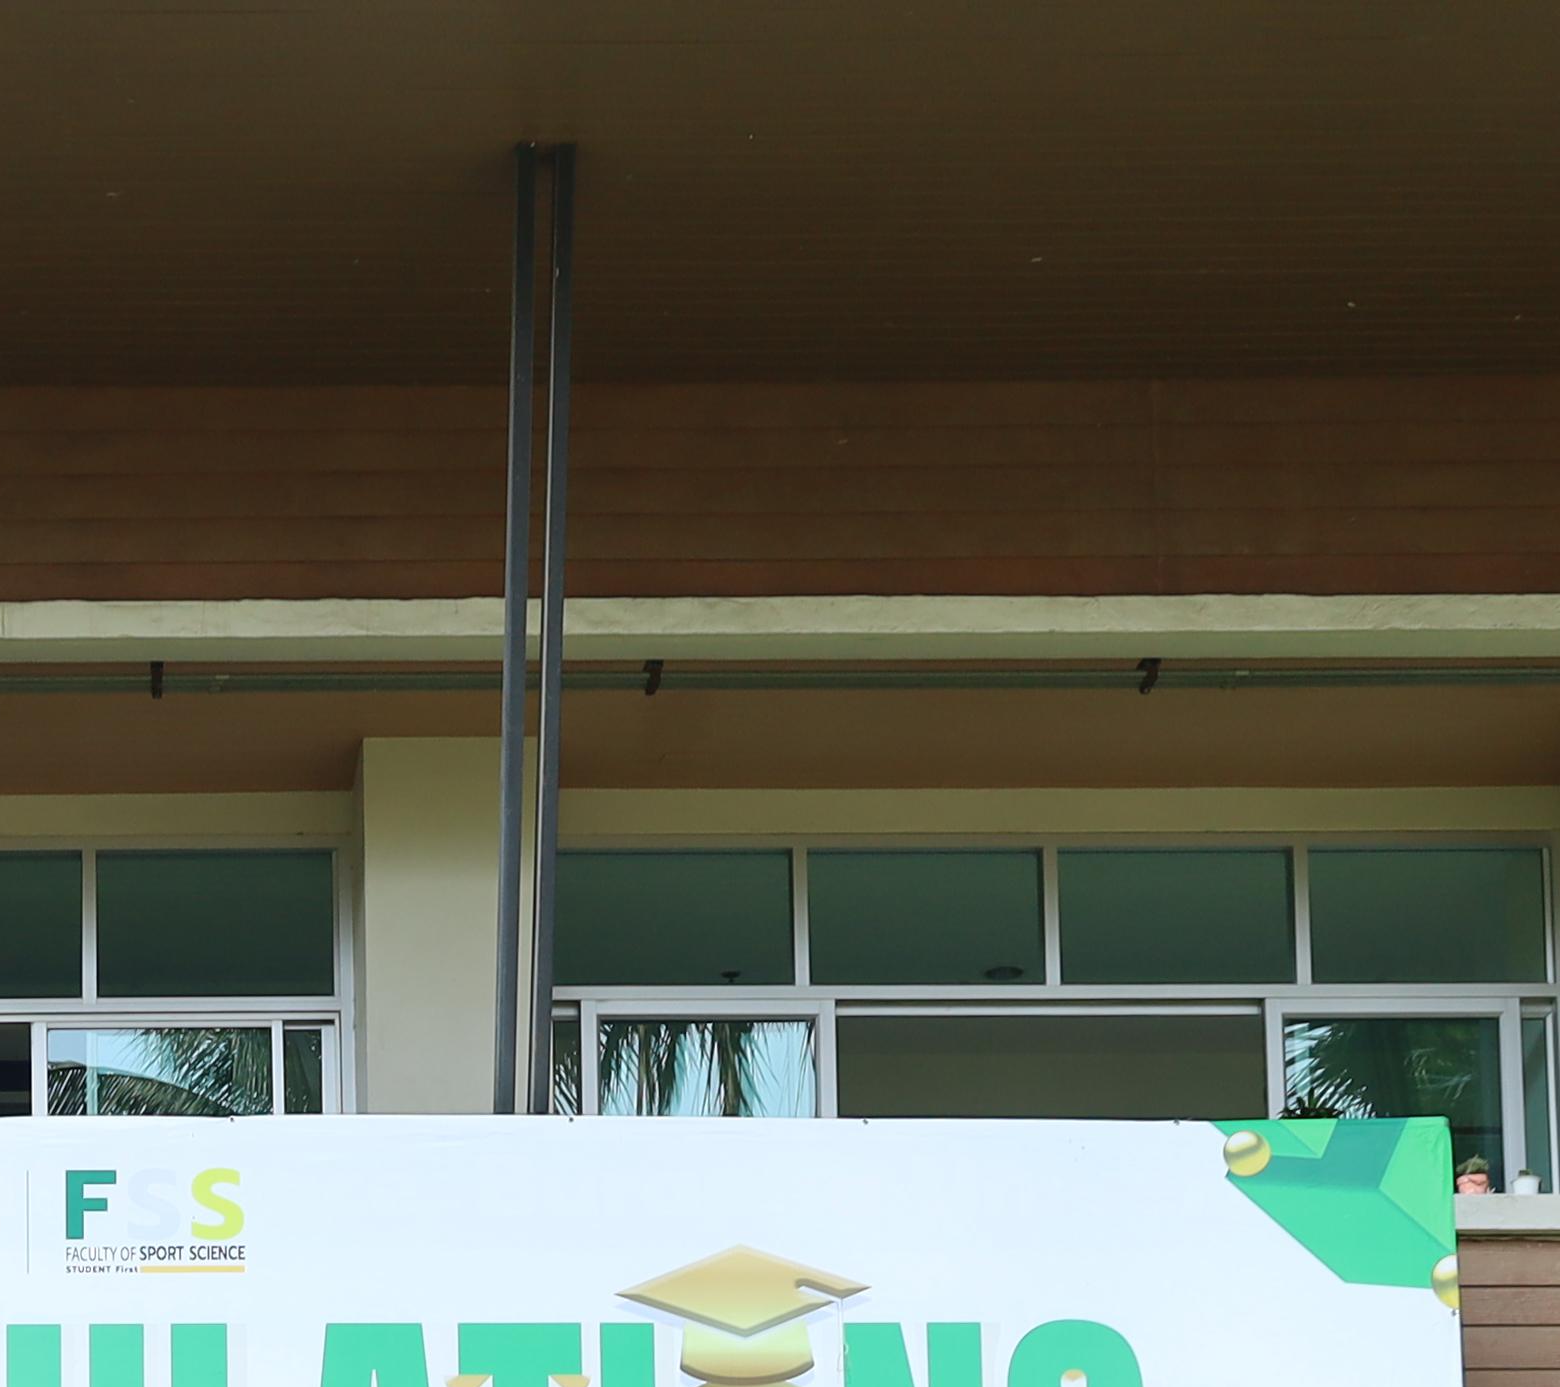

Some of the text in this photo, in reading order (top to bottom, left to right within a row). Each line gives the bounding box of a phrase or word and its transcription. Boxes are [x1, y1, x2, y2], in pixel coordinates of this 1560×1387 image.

[65, 1245, 246, 1262] FACULTY OF SPORT SCIENCE
[66, 1266, 111, 1274] STUDENT
